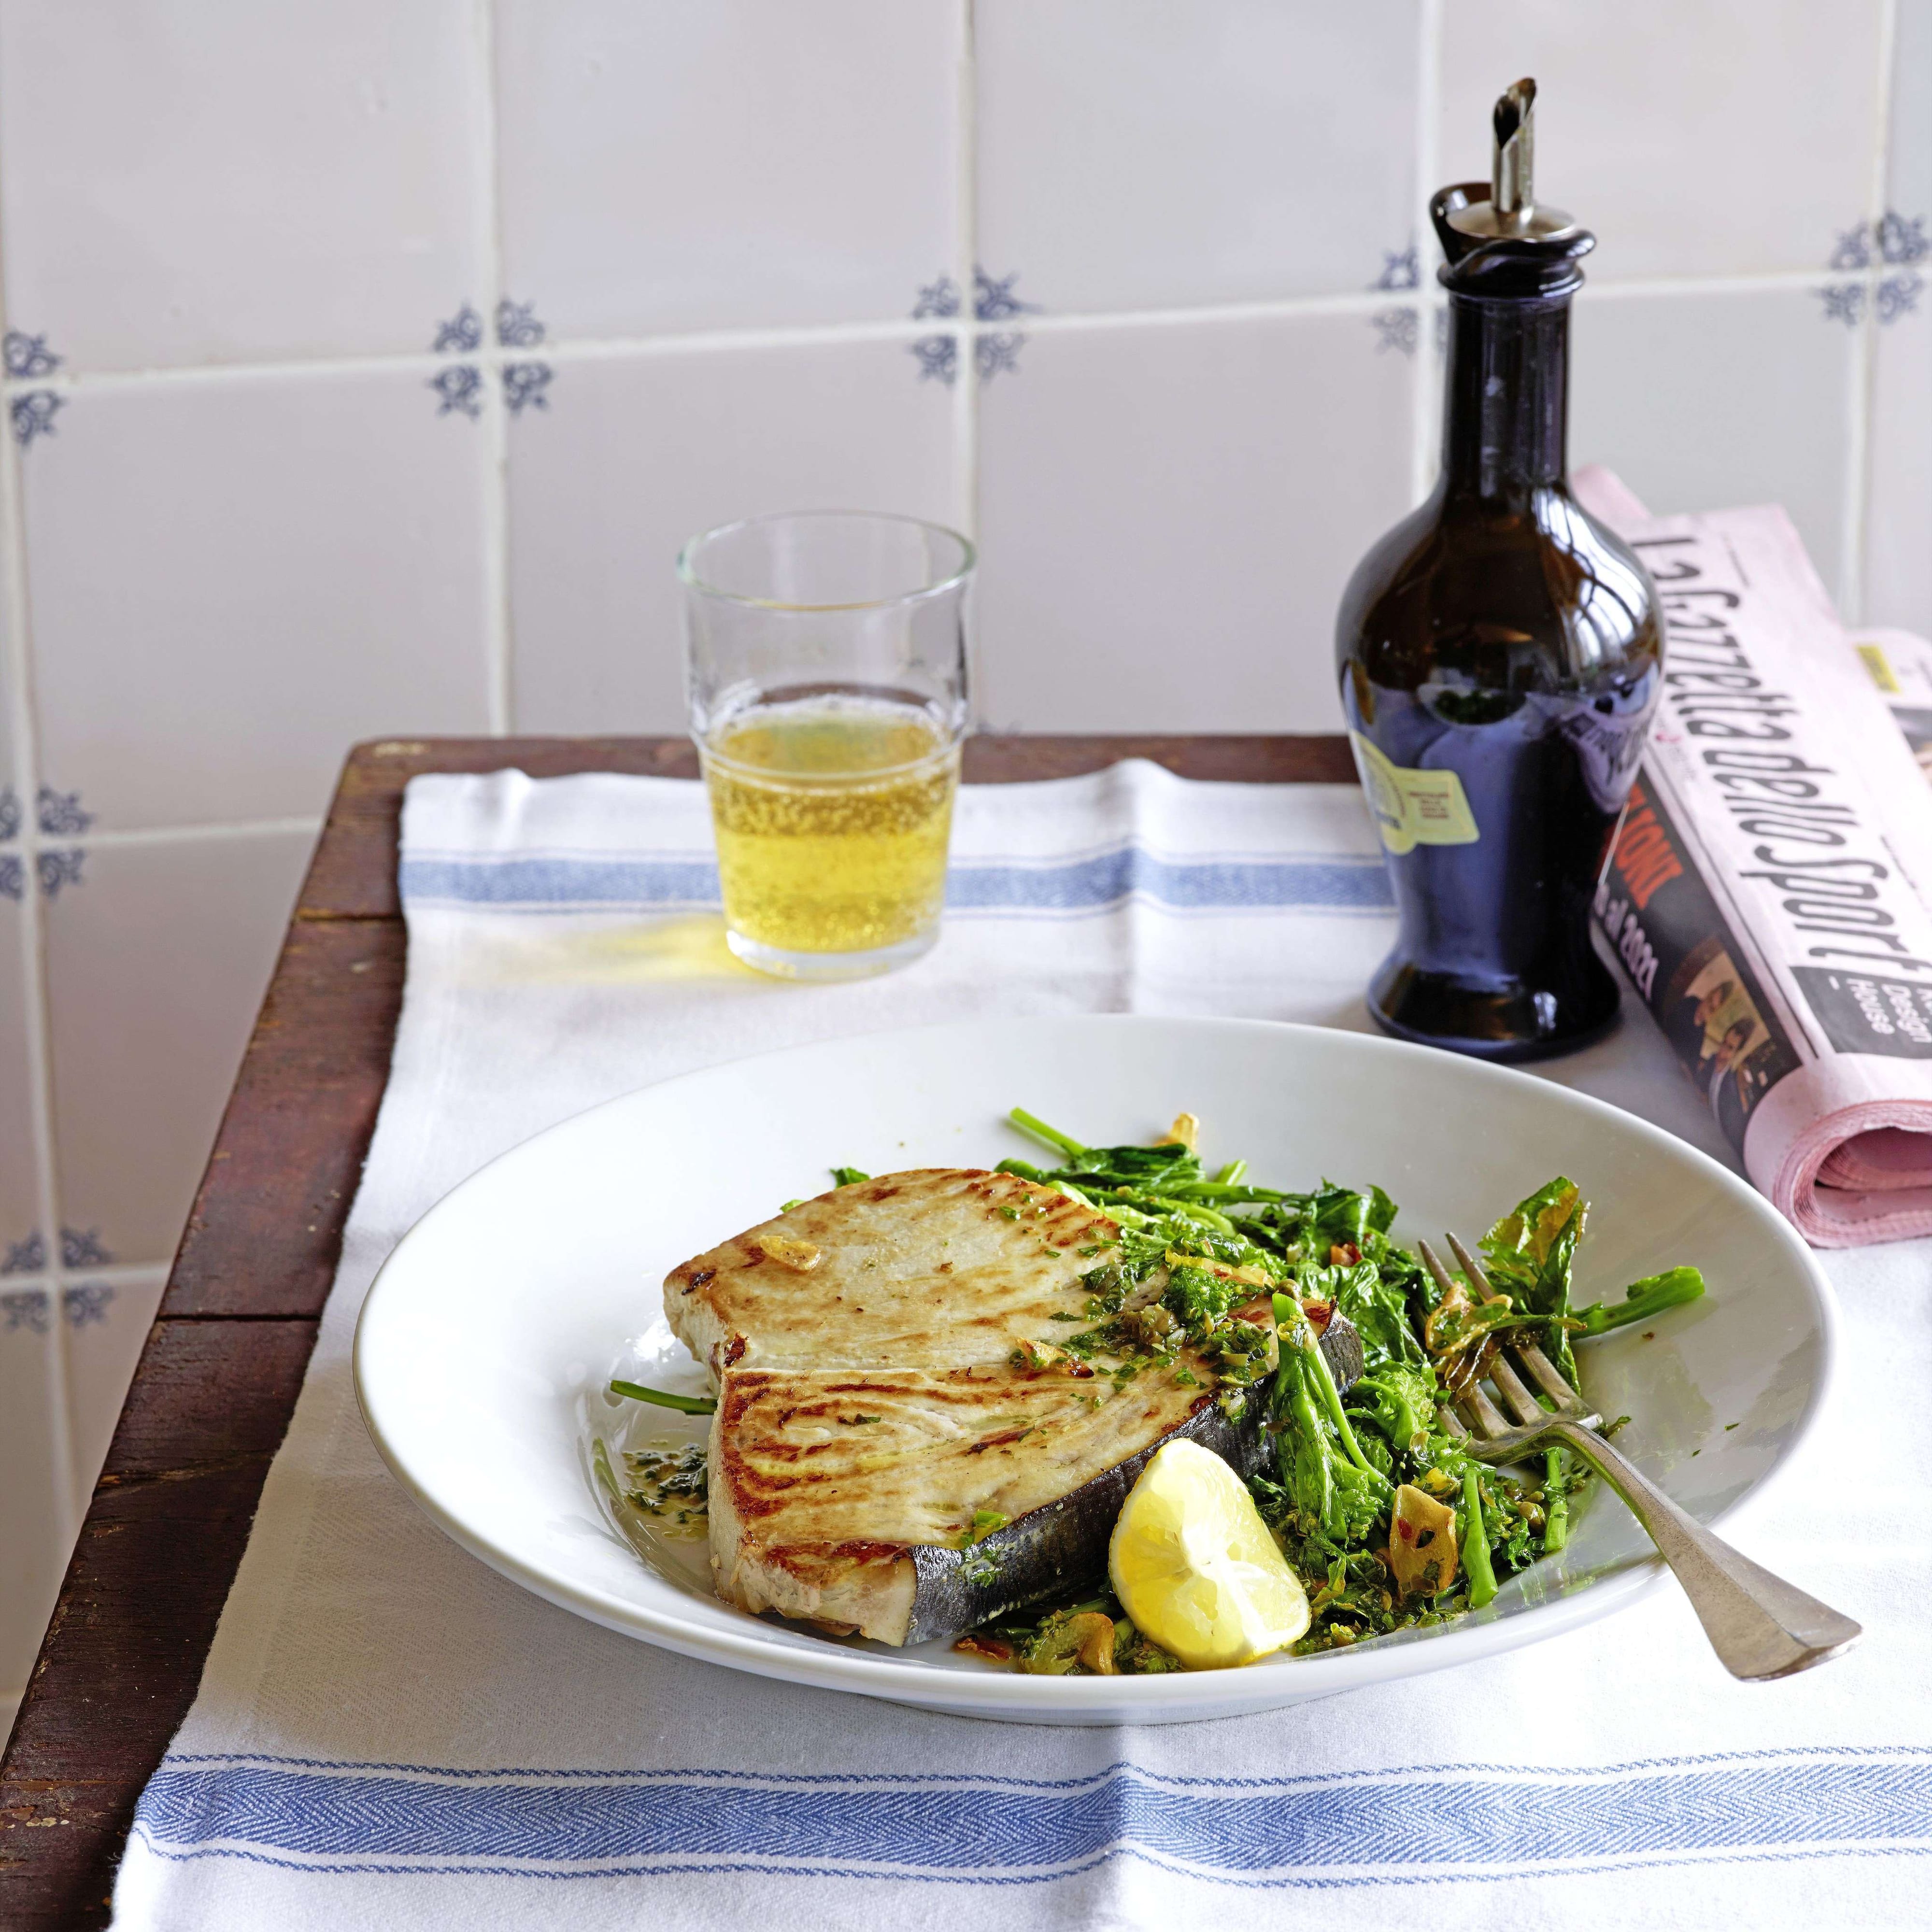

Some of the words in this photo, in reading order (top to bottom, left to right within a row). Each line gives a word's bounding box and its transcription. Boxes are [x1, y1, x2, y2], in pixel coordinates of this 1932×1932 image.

[1661, 589, 1802, 740] Gazzetta
[1703, 750, 1861, 846] dello
[1739, 844, 1932, 972] Sport
[1846, 978, 1895, 1035] House
[1881, 982, 1932, 1043] Design
